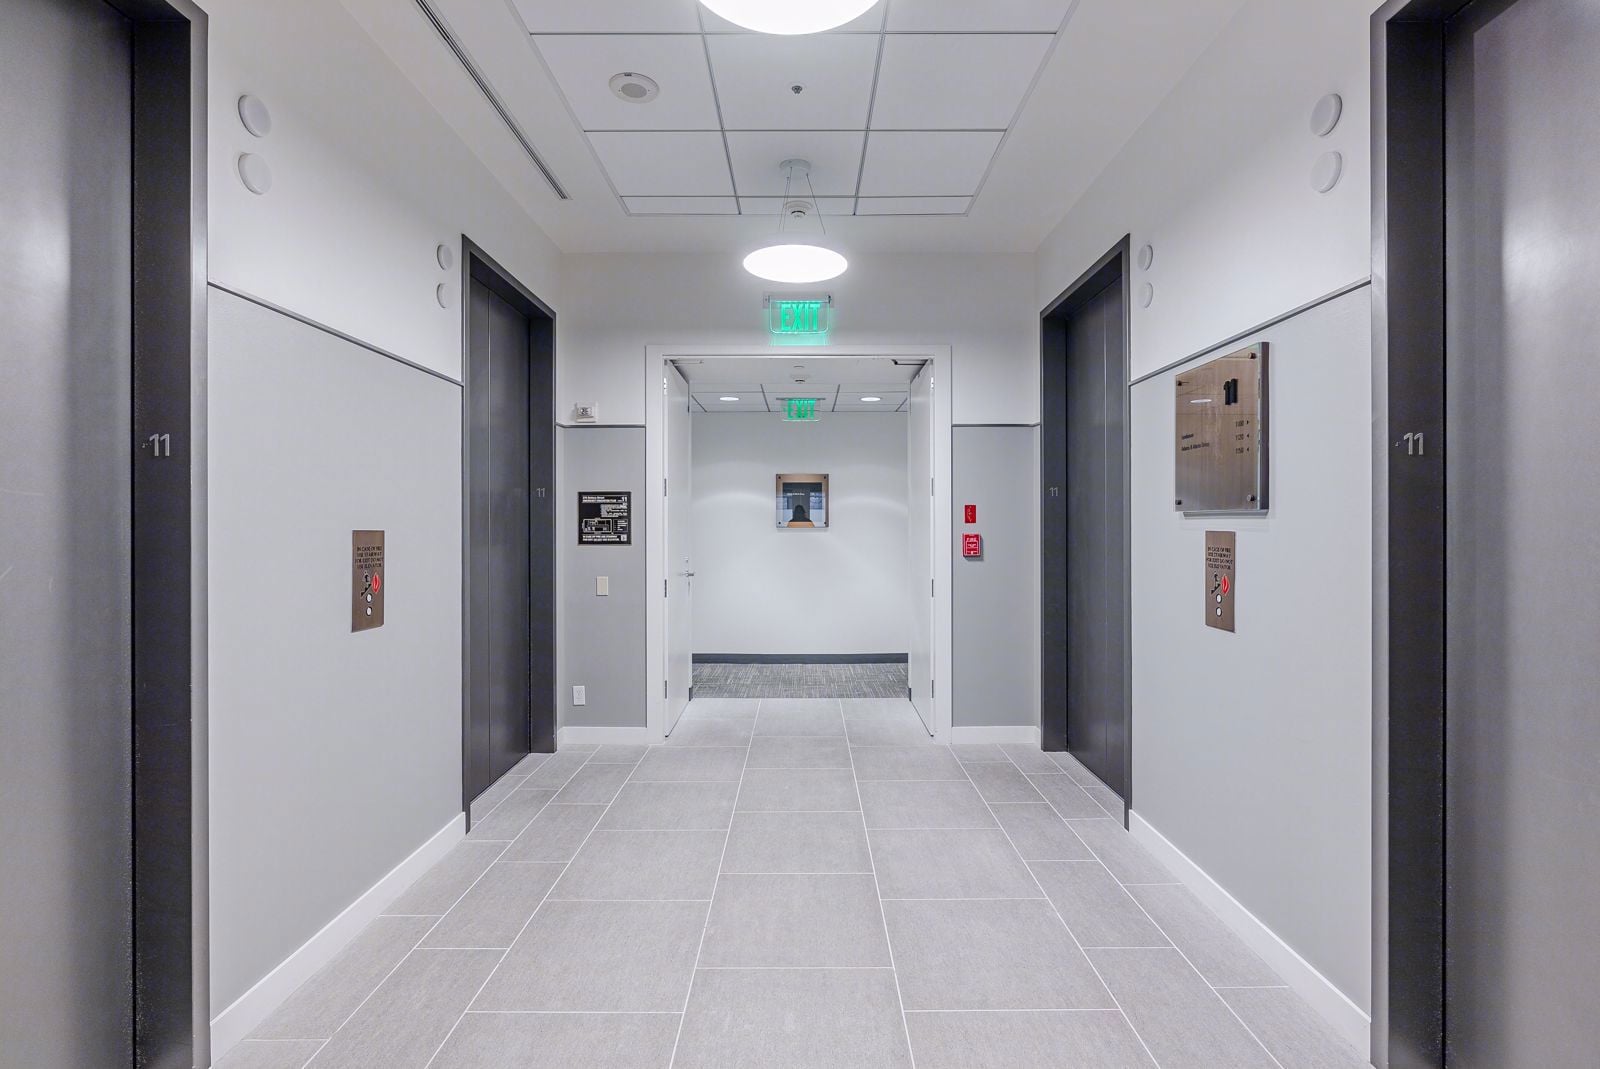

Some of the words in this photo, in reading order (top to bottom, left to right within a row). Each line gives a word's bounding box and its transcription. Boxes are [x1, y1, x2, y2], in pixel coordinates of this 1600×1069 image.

[781, 303, 820, 331] EXIT
[1223, 378, 1238, 406] 11
[787, 400, 816, 419] EXIT
[149, 433, 170, 457] 11
[1403, 432, 1424, 456] 11
[536, 488, 546, 498] 11
[1049, 488, 1058, 496] 11
